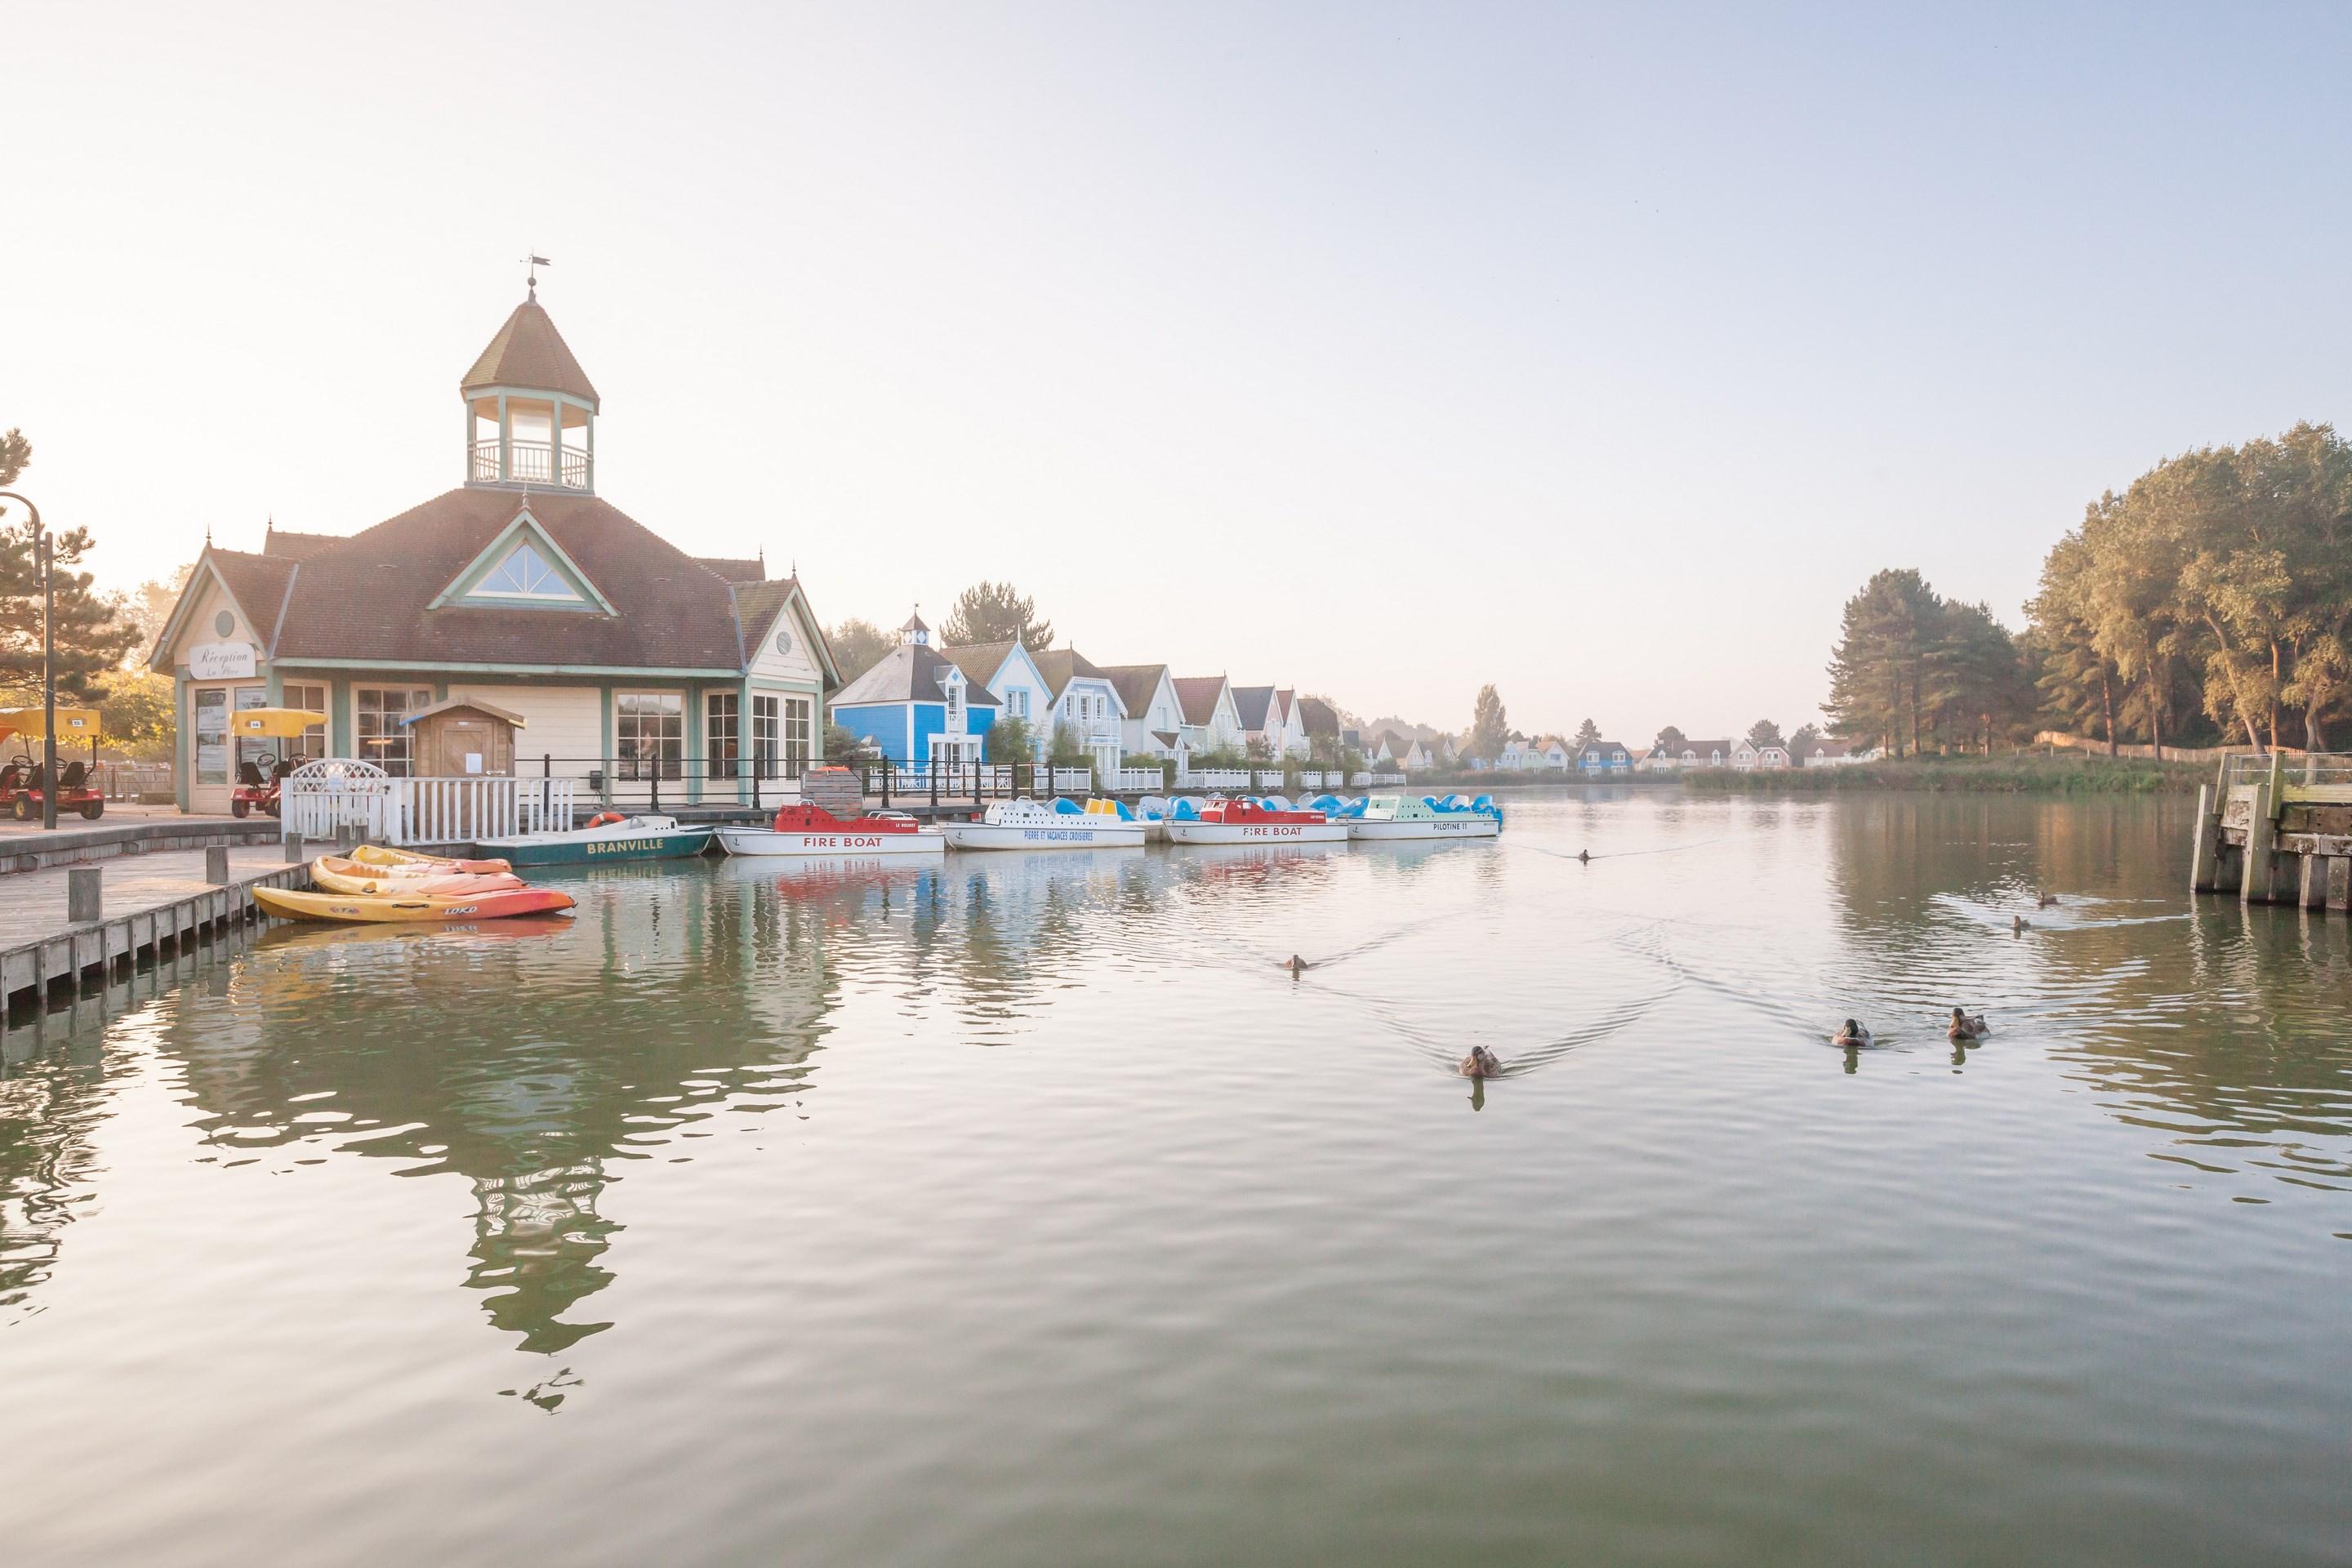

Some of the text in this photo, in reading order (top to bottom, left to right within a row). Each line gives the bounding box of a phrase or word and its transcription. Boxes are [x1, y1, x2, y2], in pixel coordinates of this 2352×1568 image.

[201, 648, 248, 669] Réception
[1024, 831, 1040, 840] PIERRE
[1040, 831, 1045, 840] ET
[1047, 831, 1068, 840] VACANCES
[1243, 826, 1302, 836] FIRE BOAT
[587, 839, 664, 854] BRANVILLE
[804, 837, 883, 847] FIRE BOAT
